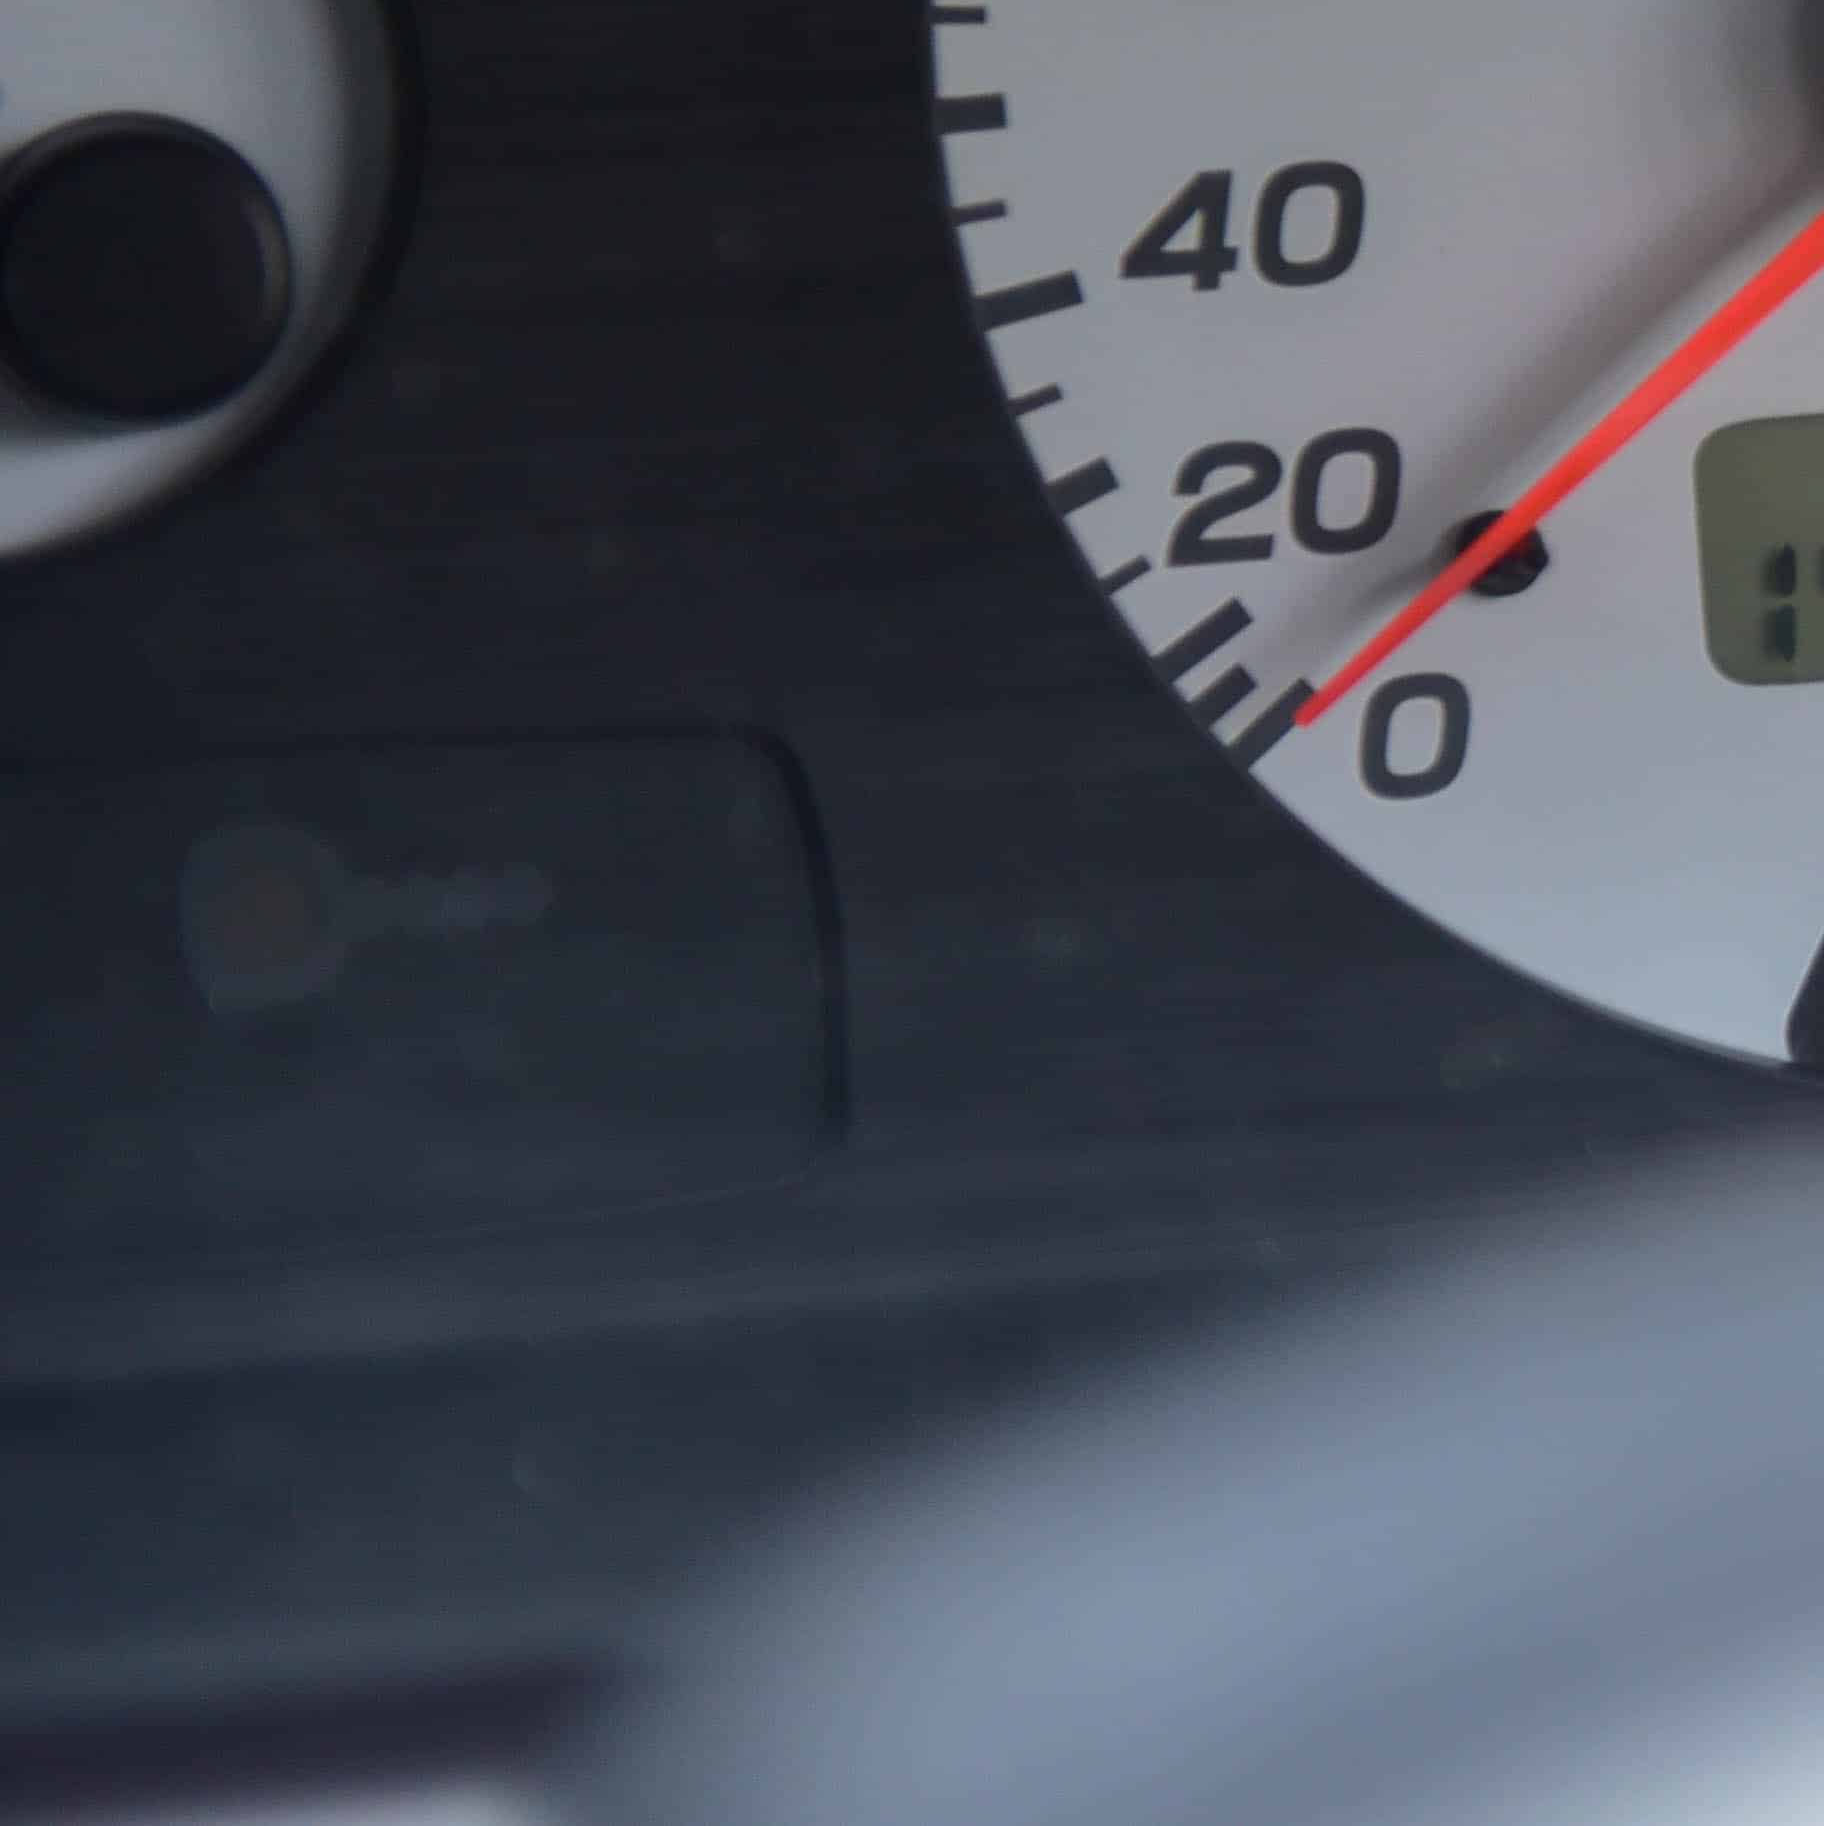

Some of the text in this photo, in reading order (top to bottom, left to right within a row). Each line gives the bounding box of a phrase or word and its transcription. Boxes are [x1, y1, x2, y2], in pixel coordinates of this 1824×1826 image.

[1121, 160, 1366, 291] 40
[1168, 427, 1401, 567] 20
[1357, 671, 1472, 800] 0
